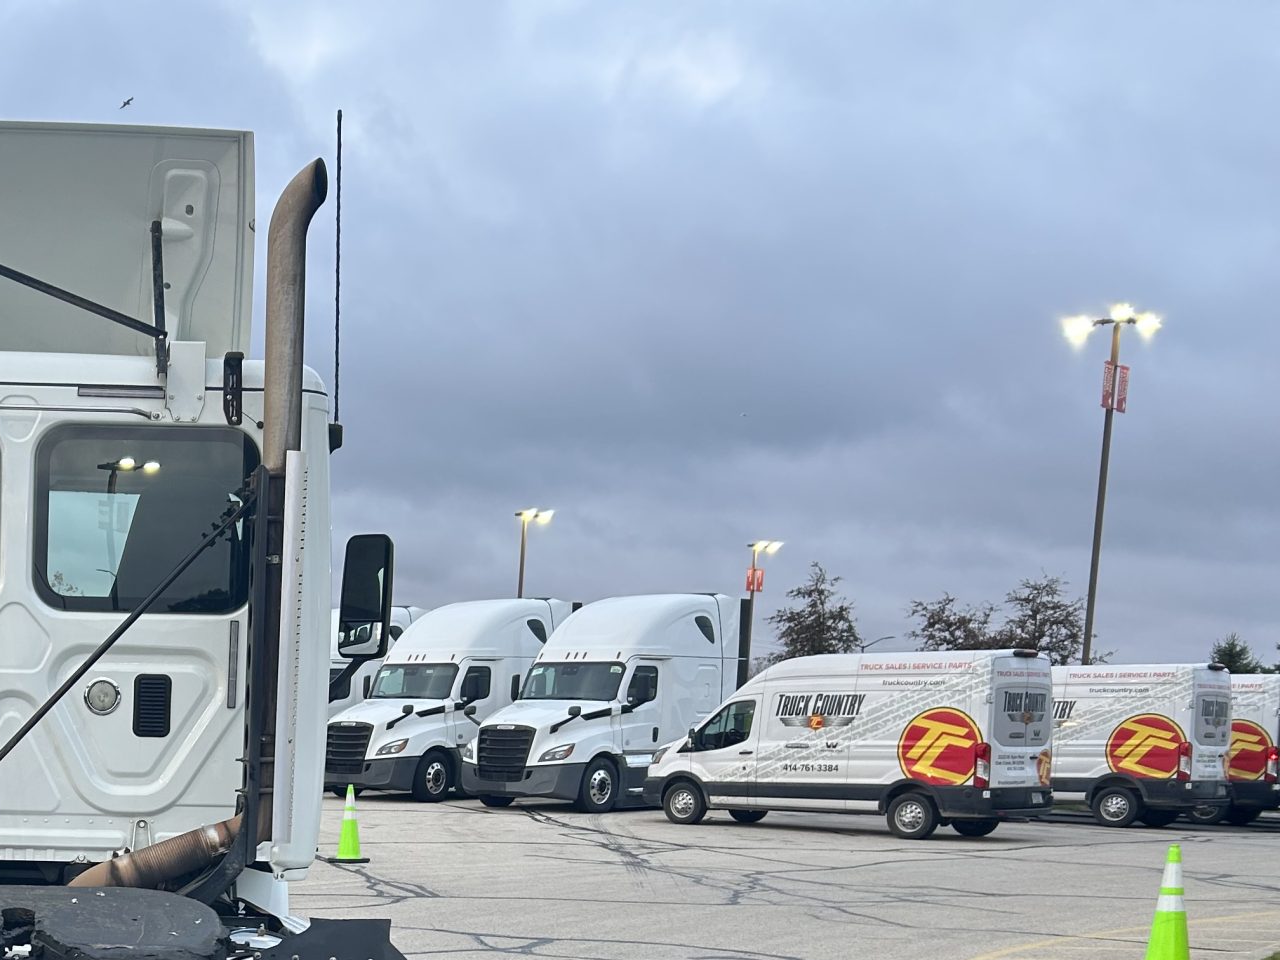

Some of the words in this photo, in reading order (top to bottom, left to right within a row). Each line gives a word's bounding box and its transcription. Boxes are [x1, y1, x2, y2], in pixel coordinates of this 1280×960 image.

[882, 679, 946, 687] truckcountry.com
[776, 694, 813, 716] TRUCK
[812, 693, 867, 716] COUNTRY
[782, 764, 839, 772] 414-761-3384
